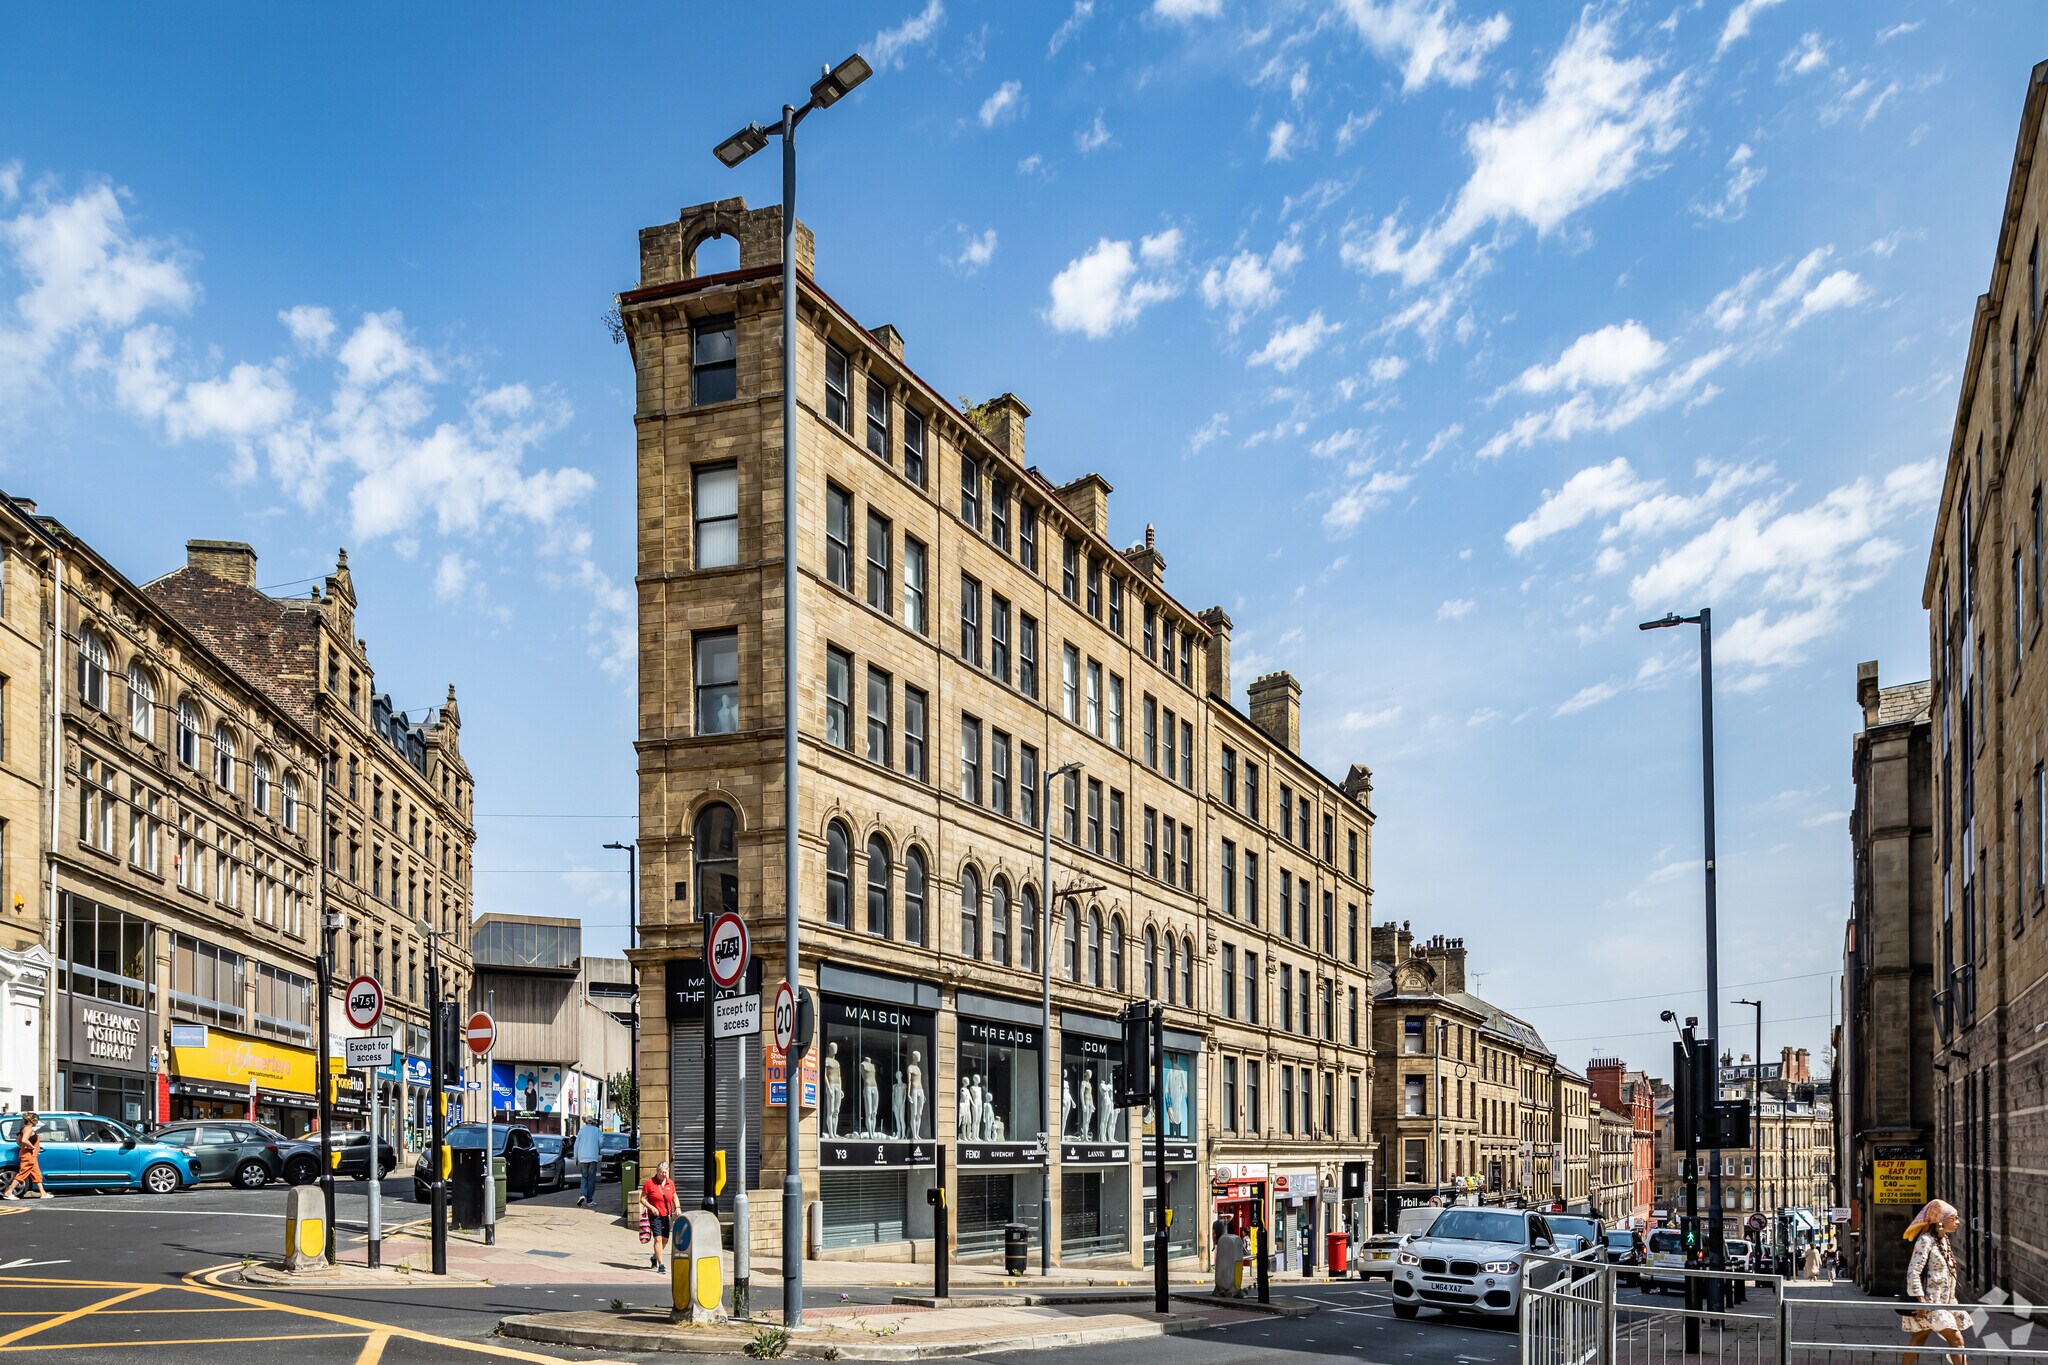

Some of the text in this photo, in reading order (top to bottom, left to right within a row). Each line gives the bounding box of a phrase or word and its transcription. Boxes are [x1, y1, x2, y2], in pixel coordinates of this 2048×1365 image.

[716, 1001, 757, 1018] Except for
[845, 1005, 911, 1027] MAISON
[83, 1008, 140, 1033] MECHANICS
[723, 1018, 750, 1031] access
[777, 1003, 792, 1035] 20
[87, 1025, 137, 1047] INSTITUTE
[970, 1025, 1033, 1044] THREADS
[90, 1041, 134, 1060] LIBRARY
[350, 1042, 376, 1054] Except
[378, 1041, 389, 1051] for
[1080, 1041, 1107, 1054] .COM
[357, 1053, 382, 1062] access
[767, 1067, 781, 1080] TO
[965, 1149, 981, 1159] FENDI
[1431, 1283, 1448, 1291] LM64
